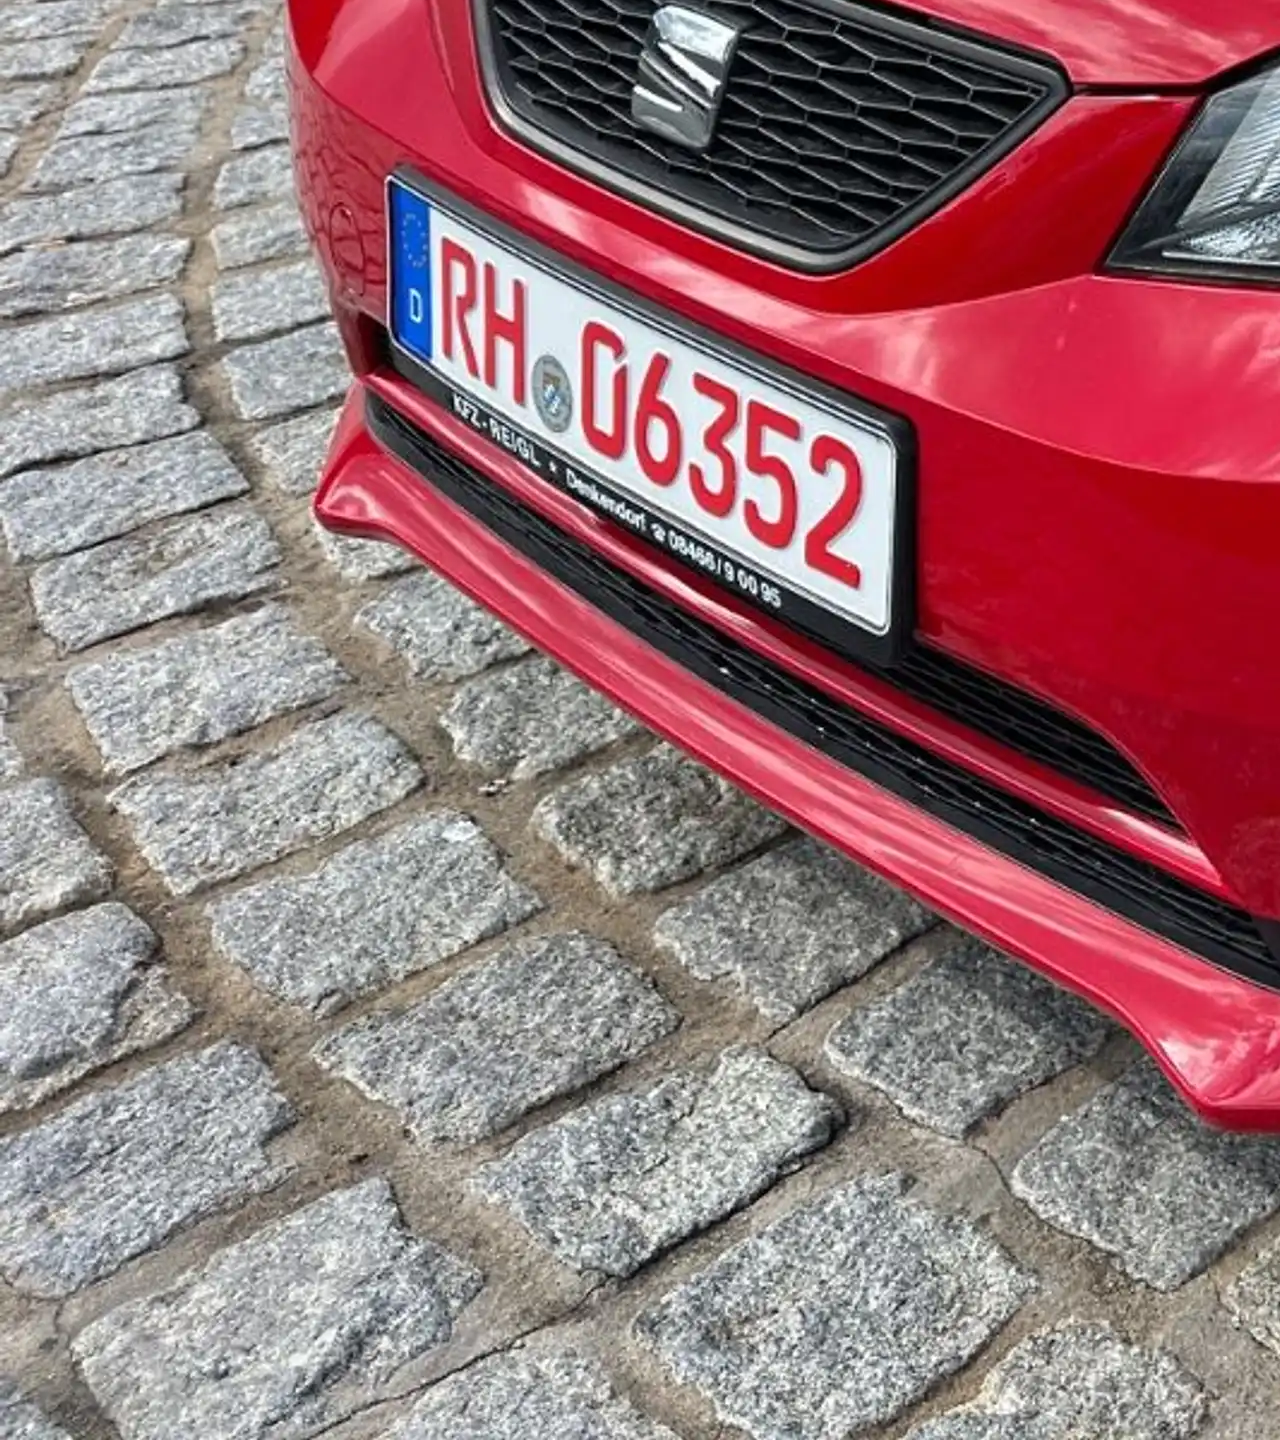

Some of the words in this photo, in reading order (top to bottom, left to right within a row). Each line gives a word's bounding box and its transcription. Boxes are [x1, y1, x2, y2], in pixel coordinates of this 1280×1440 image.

[408, 287, 422, 323] D
[441, 235, 527, 407] RH
[580, 321, 863, 589] 06352
